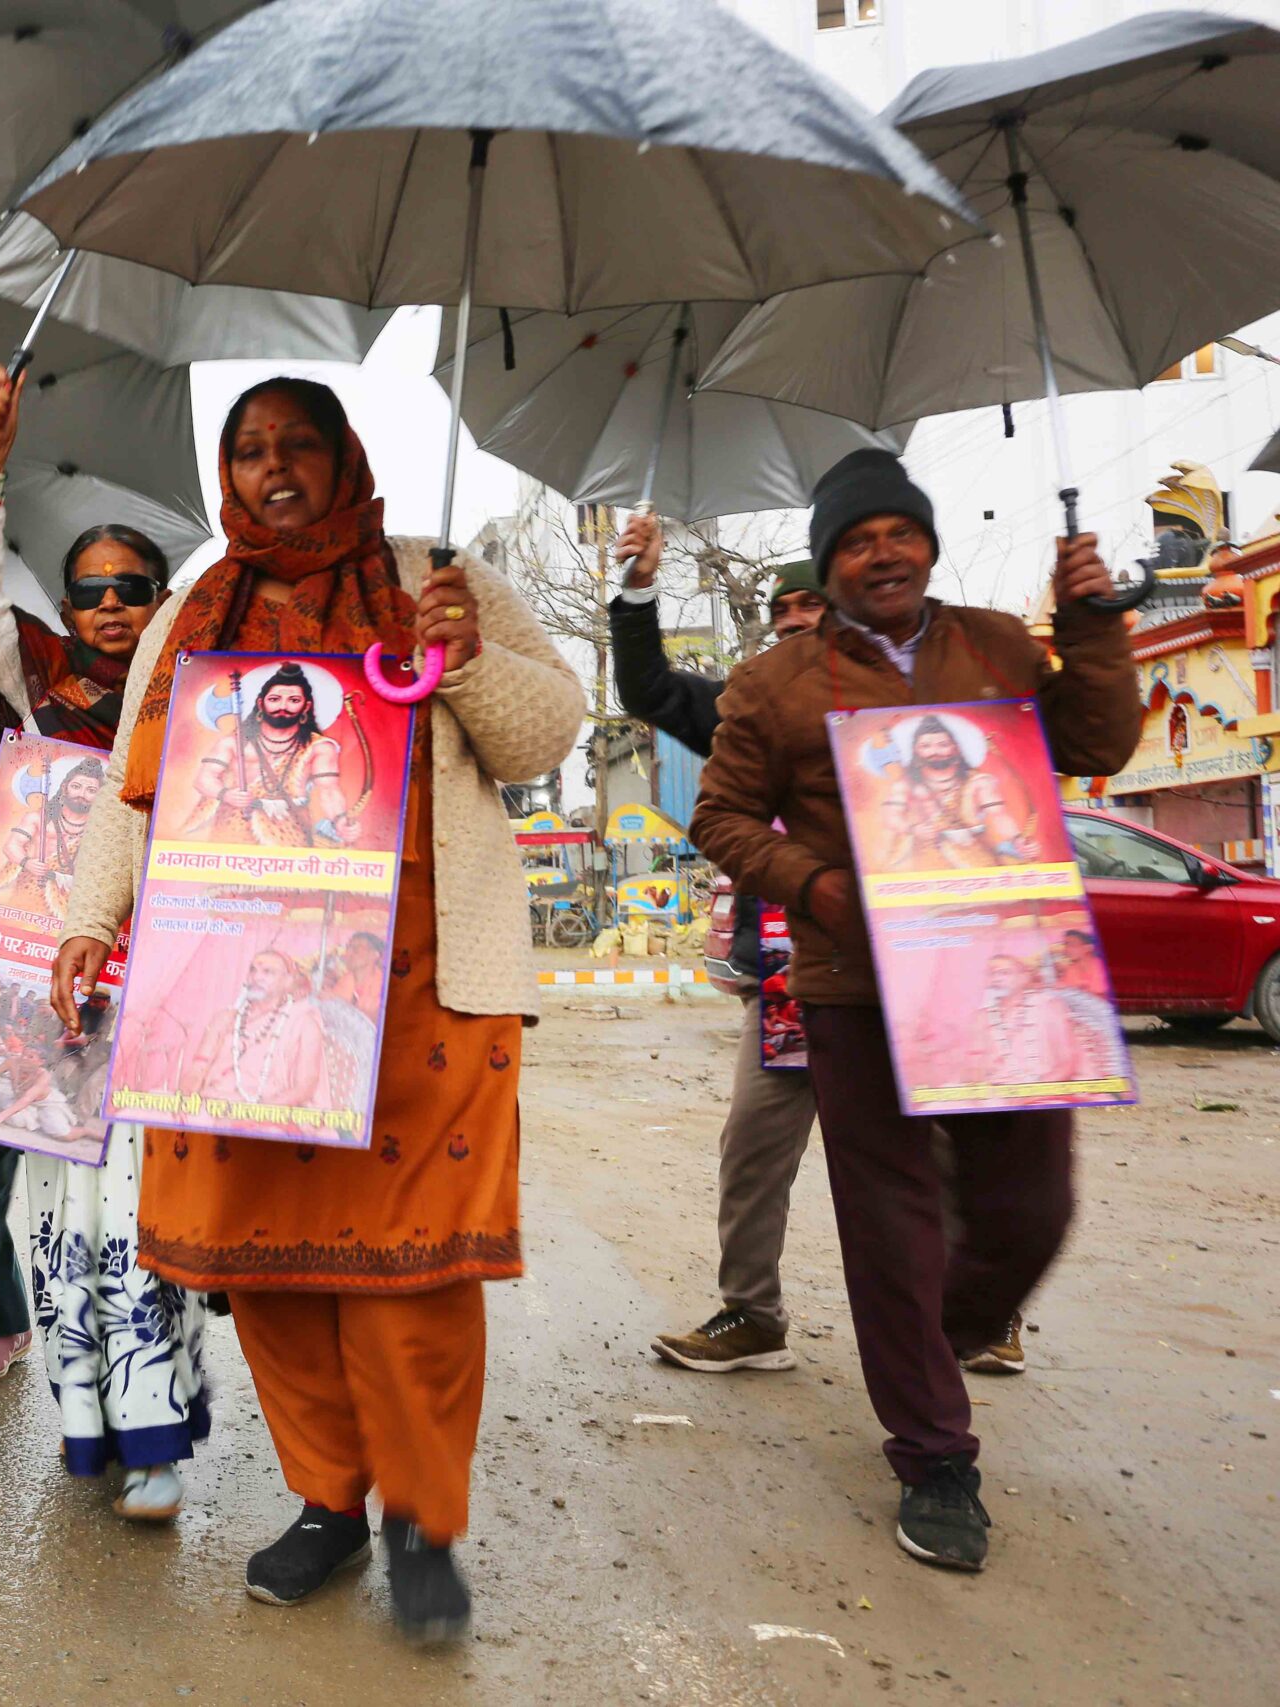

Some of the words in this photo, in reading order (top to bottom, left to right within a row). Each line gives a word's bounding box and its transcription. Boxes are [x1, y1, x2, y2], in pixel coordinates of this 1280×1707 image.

[157, 852, 220, 869] भगवान
[225, 853, 294, 876] परशुराम
[298, 856, 320, 875] जी
[325, 857, 349, 876] की
[353, 862, 385, 878] जय
[23, 911, 64, 930] परशुरा
[4, 936, 22, 953] पर
[181, 1091, 200, 1115] जी
[206, 1099, 226, 1118] पर
